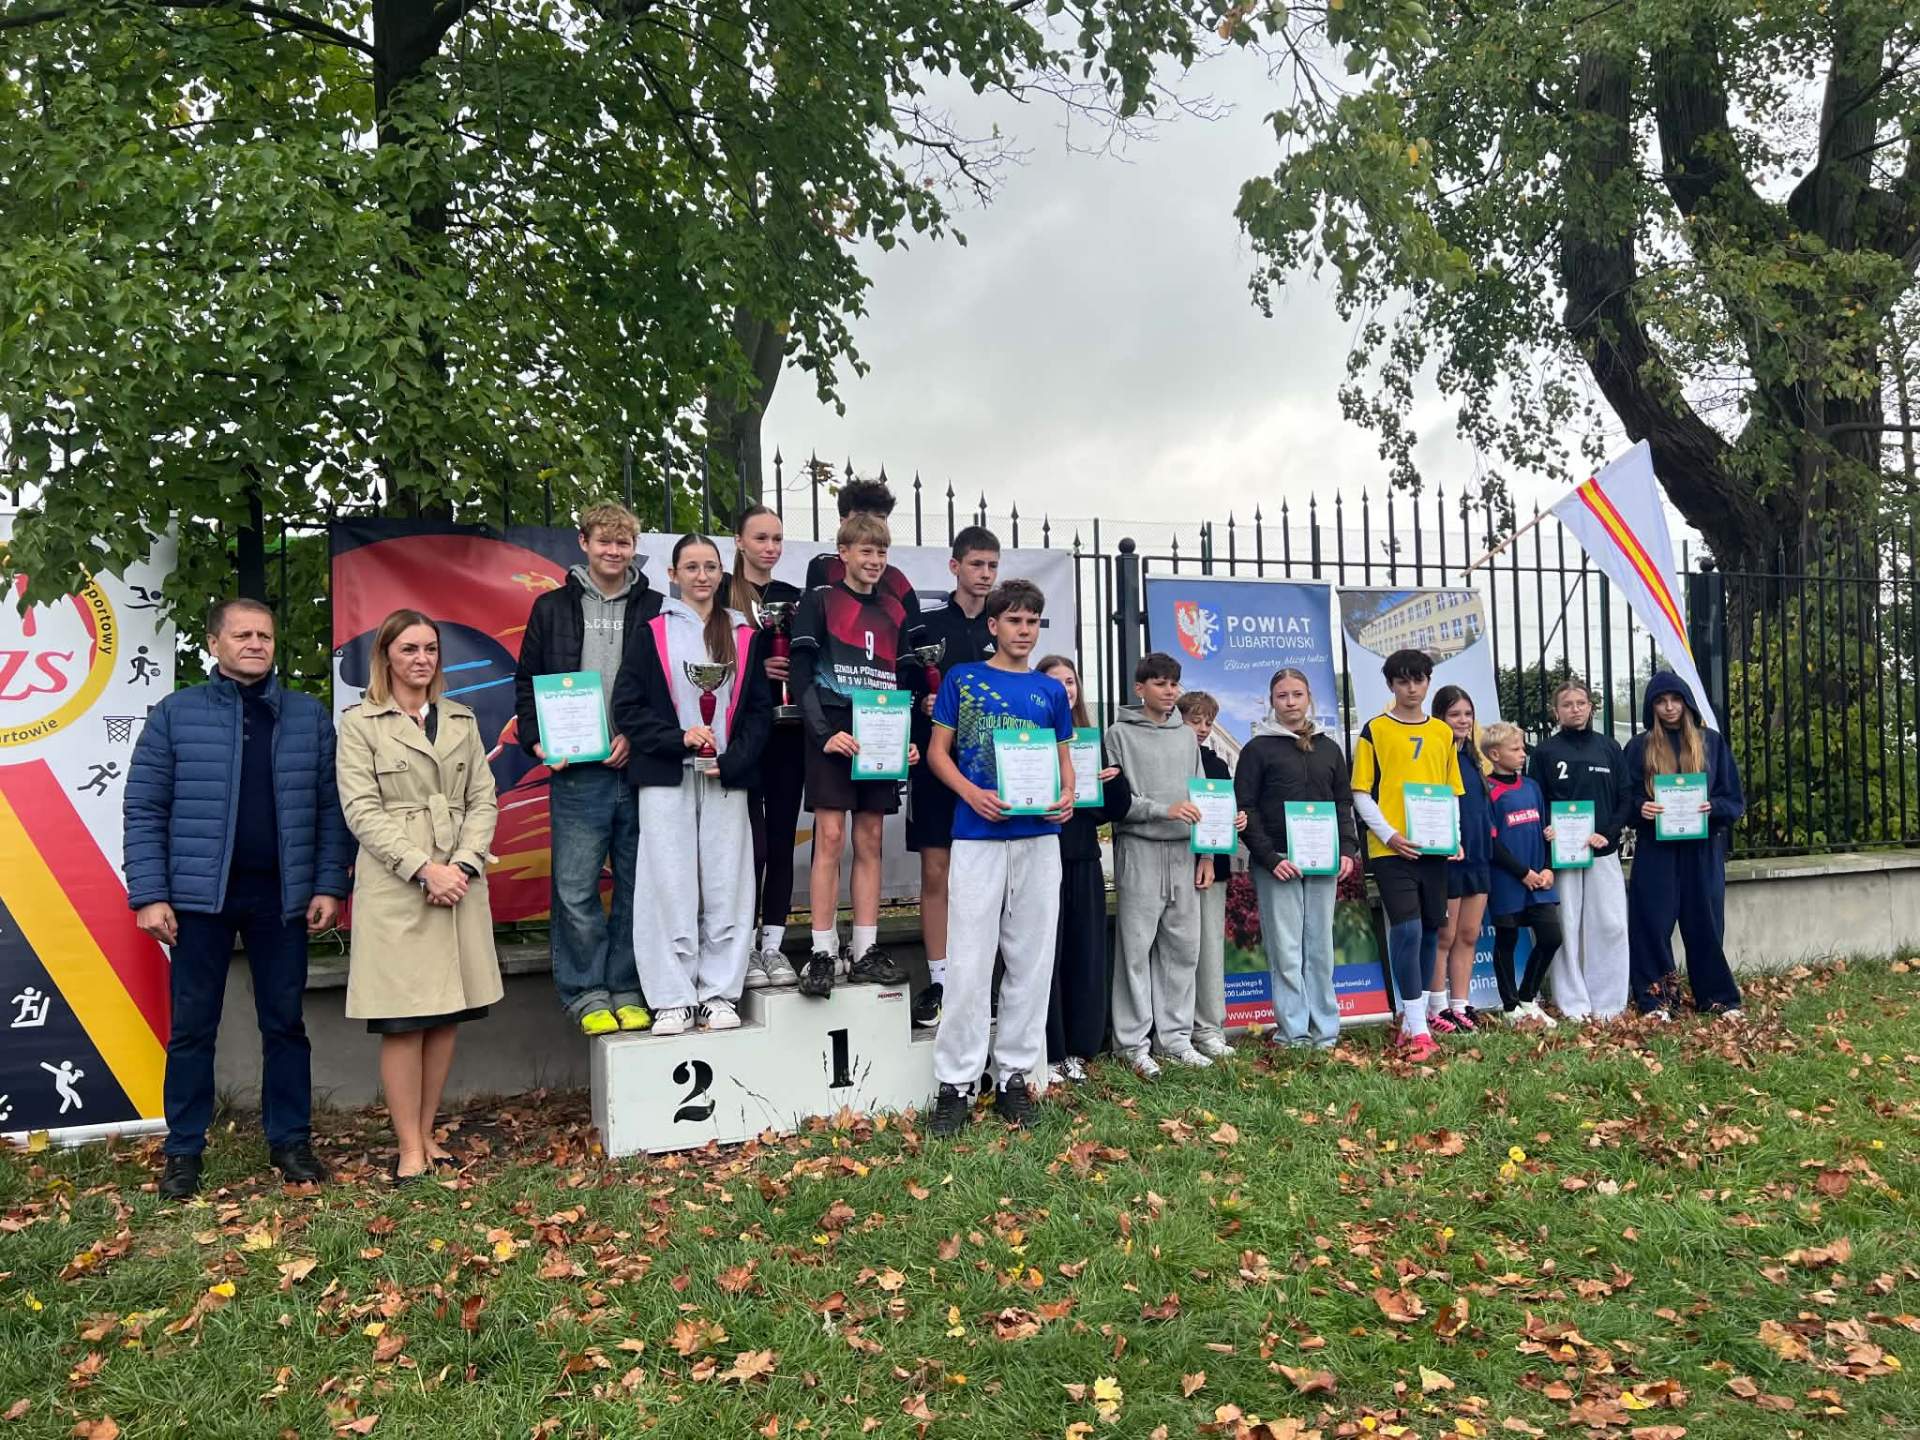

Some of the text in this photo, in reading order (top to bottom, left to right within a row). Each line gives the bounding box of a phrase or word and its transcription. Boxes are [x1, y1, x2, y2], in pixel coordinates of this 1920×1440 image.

[1226, 615, 1311, 634] POWIAT
[864, 630, 875, 660] 9
[1229, 636, 1315, 649] LUBARTOWSKI
[0, 650, 74, 701] ZS
[0, 718, 58, 744] rtowie
[1409, 737, 1423, 760] 7
[1557, 761, 1569, 780] 2
[1224, 979, 1257, 988] łowackiego
[1227, 1008, 1275, 1020] www.pow
[827, 1028, 854, 1089] 1
[672, 1059, 716, 1124] 2
